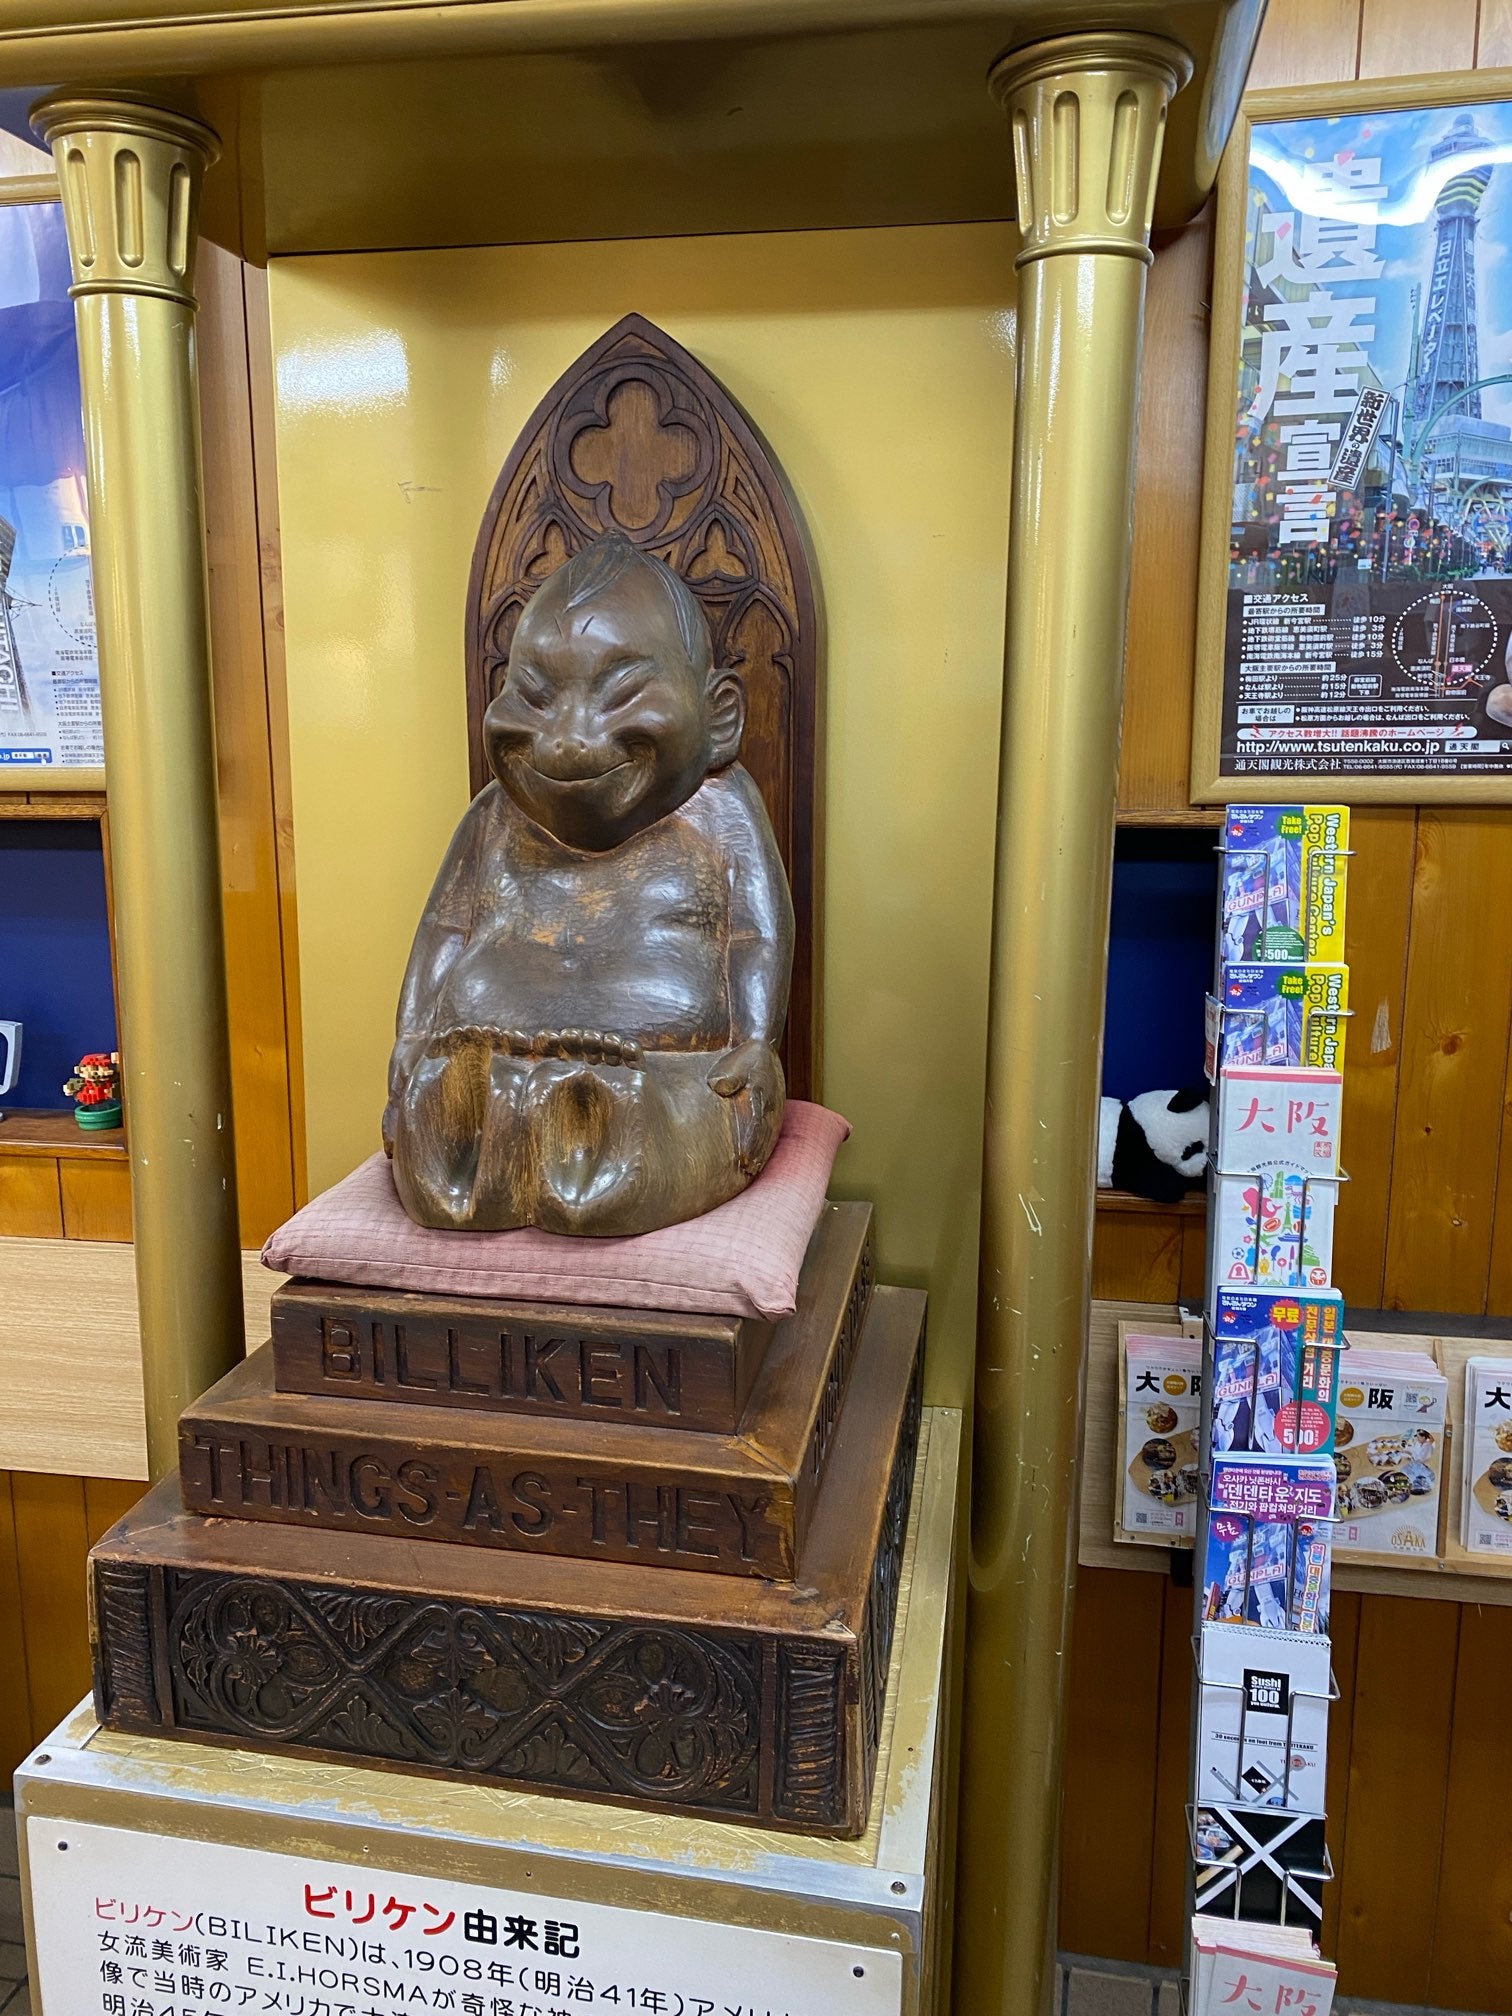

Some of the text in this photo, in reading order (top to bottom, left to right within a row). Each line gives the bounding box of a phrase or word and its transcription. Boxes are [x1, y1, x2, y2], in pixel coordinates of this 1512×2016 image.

[1422, 240, 1451, 373] 日立エレベーター
[1248, 606, 1321, 615] 最寄駅からの所要時間
[1321, 674, 1347, 682] 約25分
[1320, 691, 1346, 699] 約12分
[1236, 739, 1441, 755] http://www.tsutenkaku.co.jp
[1234, 758, 1342, 770] 通天閣観光株式会社
[1281, 815, 1302, 825] Take
[1280, 824, 1303, 834] Free!
[1307, 813, 1324, 844] Pop
[1229, 886, 1283, 911] GUNPA
[1321, 877, 1337, 936] Japan's
[1282, 975, 1304, 985] Take
[1281, 984, 1304, 994] Free!
[1309, 974, 1326, 1003] Pop
[1233, 1097, 1330, 1137] 大阪
[1272, 1306, 1300, 1323] 무료
[319, 1315, 683, 1415] BILLIKEN
[1302, 1362, 1315, 1389] 거리
[1219, 1374, 1278, 1397] GUNA
[1222, 1474, 1248, 1484] 오사카
[1294, 1487, 1322, 1503] 지도
[1229, 1500, 1258, 1512] 전기와
[1298, 1504, 1318, 1516] 거리
[1250, 1675, 1282, 1688] Sushi
[1249, 1688, 1280, 1704] 100
[1223, 1735, 1248, 1743] secos
[304, 1884, 580, 1959] ビリケン由来記
[97, 1930, 229, 1972] 女流美術家
